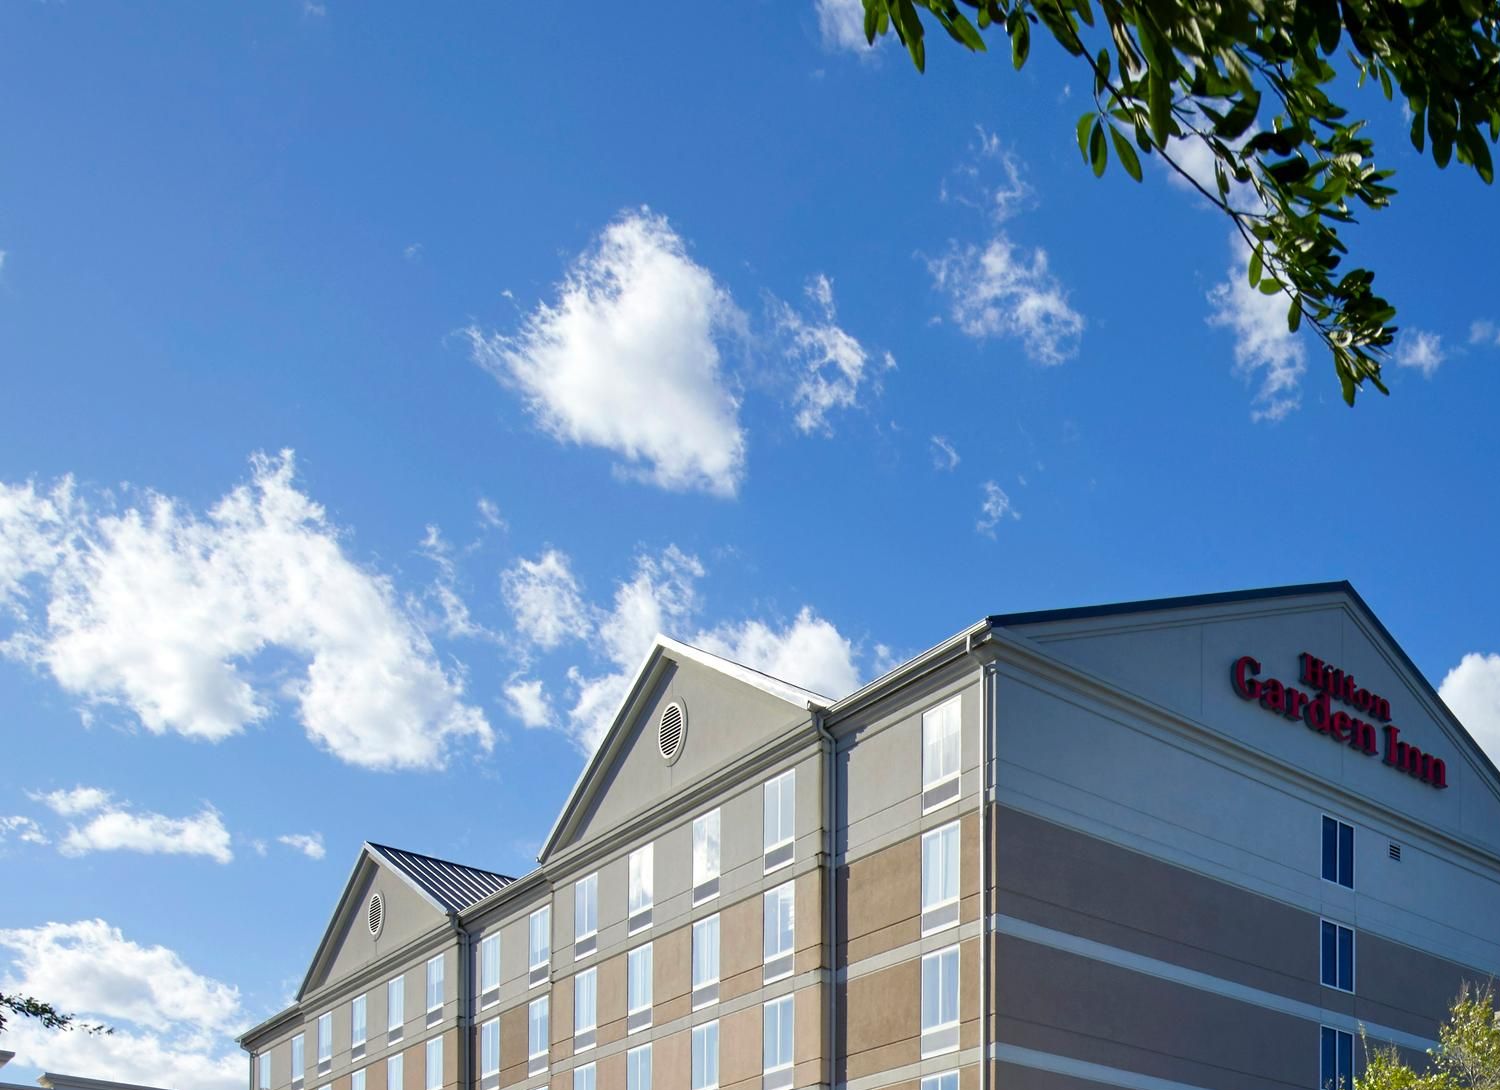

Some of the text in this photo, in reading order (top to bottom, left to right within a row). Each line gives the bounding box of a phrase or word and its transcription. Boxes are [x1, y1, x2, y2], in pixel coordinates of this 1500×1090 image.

[1231, 655, 1448, 789] Garden Inn
[1298, 652, 1392, 722] Hilton
